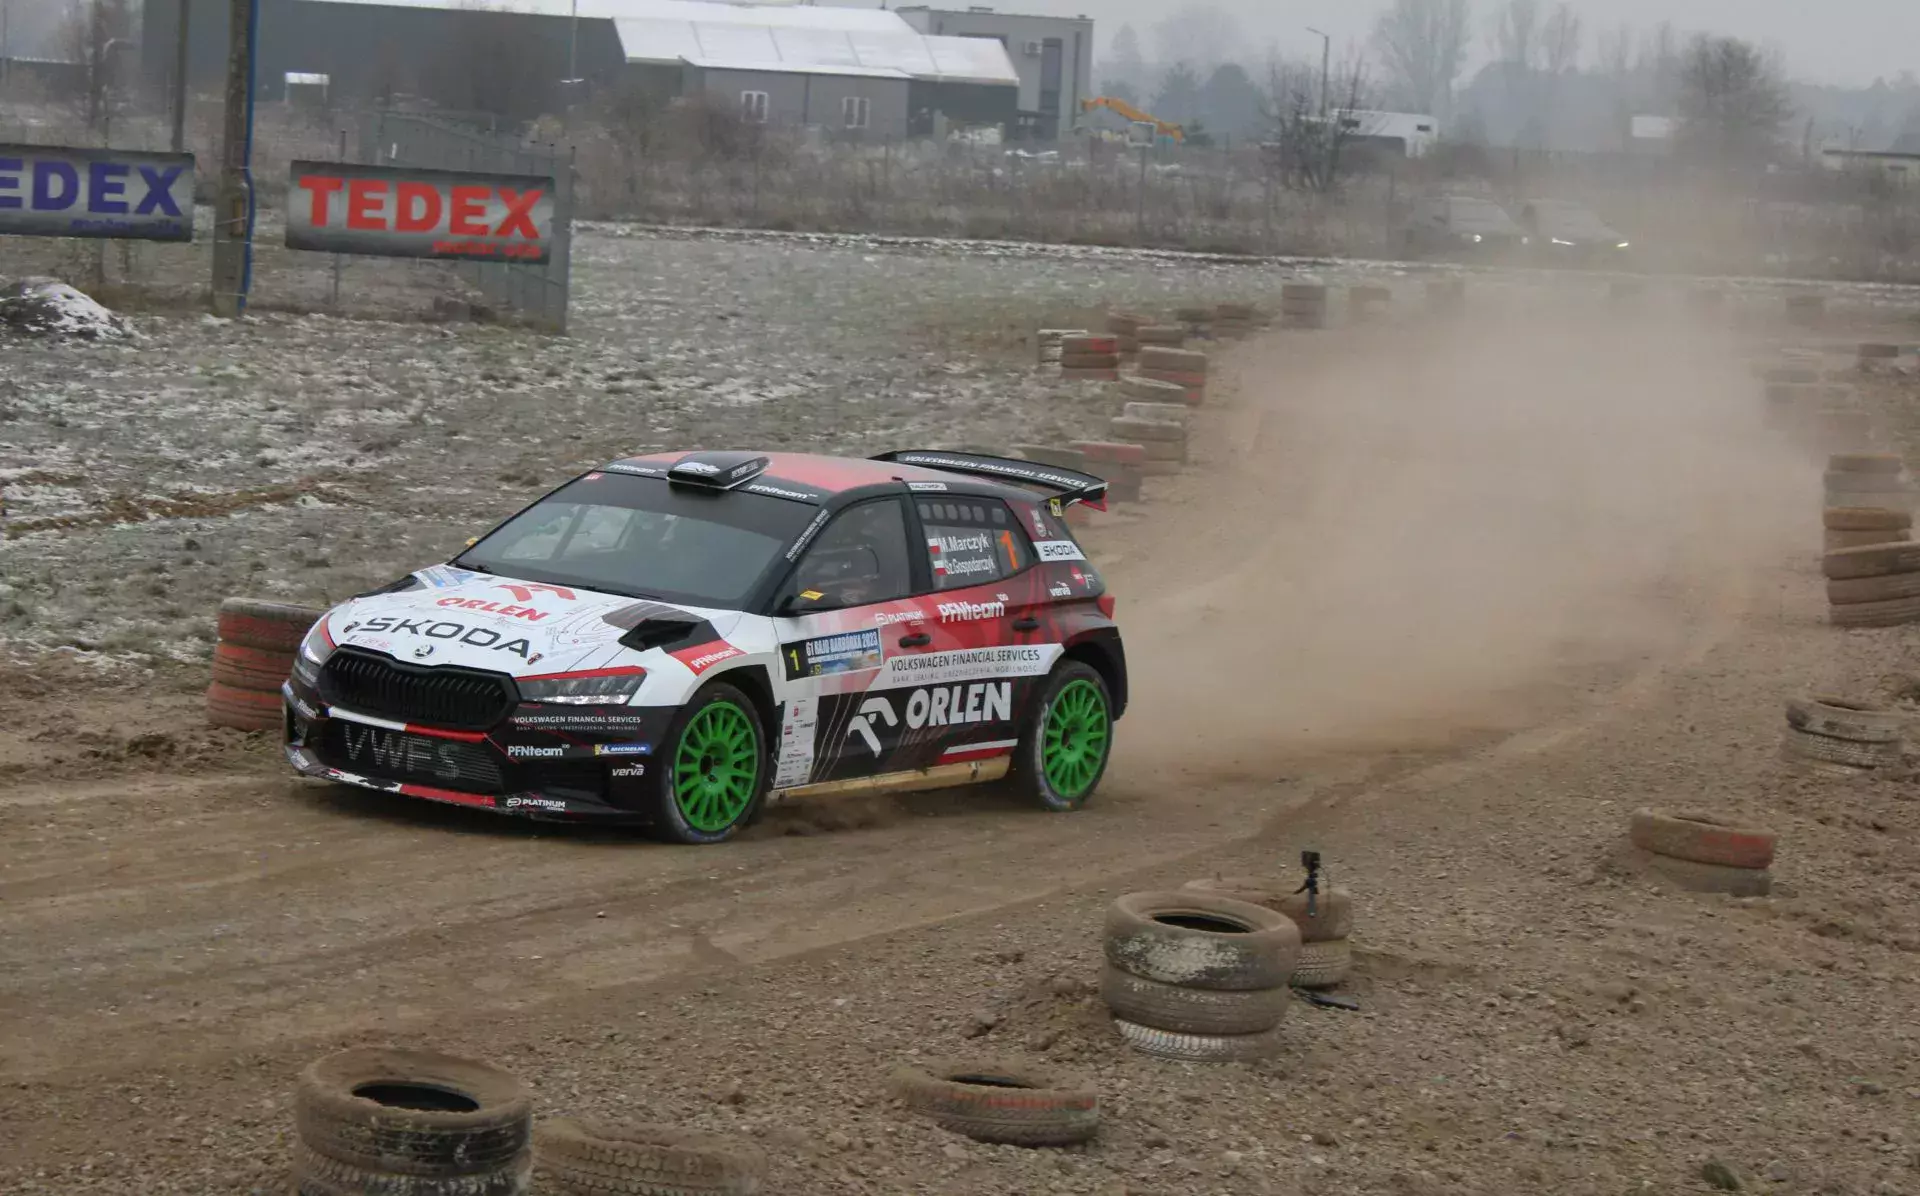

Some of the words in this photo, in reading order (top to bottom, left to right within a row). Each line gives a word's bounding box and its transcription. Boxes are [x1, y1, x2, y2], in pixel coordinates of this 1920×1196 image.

[298, 175, 544, 239] TEDEX
[905, 455, 977, 469] VOLKSWAGEN
[978, 463, 1035, 478] FINANCIAL
[1036, 472, 1089, 488] SERVICES
[748, 484, 808, 498] PFNteam
[940, 533, 990, 553] M.Marczyk
[1000, 529, 1019, 570] 1
[436, 597, 551, 622] ORLEN
[937, 601, 1005, 624] PFNteam
[862, 631, 879, 648] 2023
[789, 649, 800, 671] 1
[891, 657, 951, 672] VOLKSWAGEN
[952, 652, 995, 666] FINANCIAL
[997, 649, 1041, 662] SERVICES
[906, 682, 1011, 729] ORLEN
[514, 716, 566, 724] VOLKSWAGEN
[567, 716, 607, 724] FINANCIAL
[608, 715, 641, 724] SERVICES
[345, 724, 459, 780] VWFS
[507, 745, 563, 757] PFNteam
[612, 766, 645, 777] verva
[522, 799, 566, 809] PLATINUM
